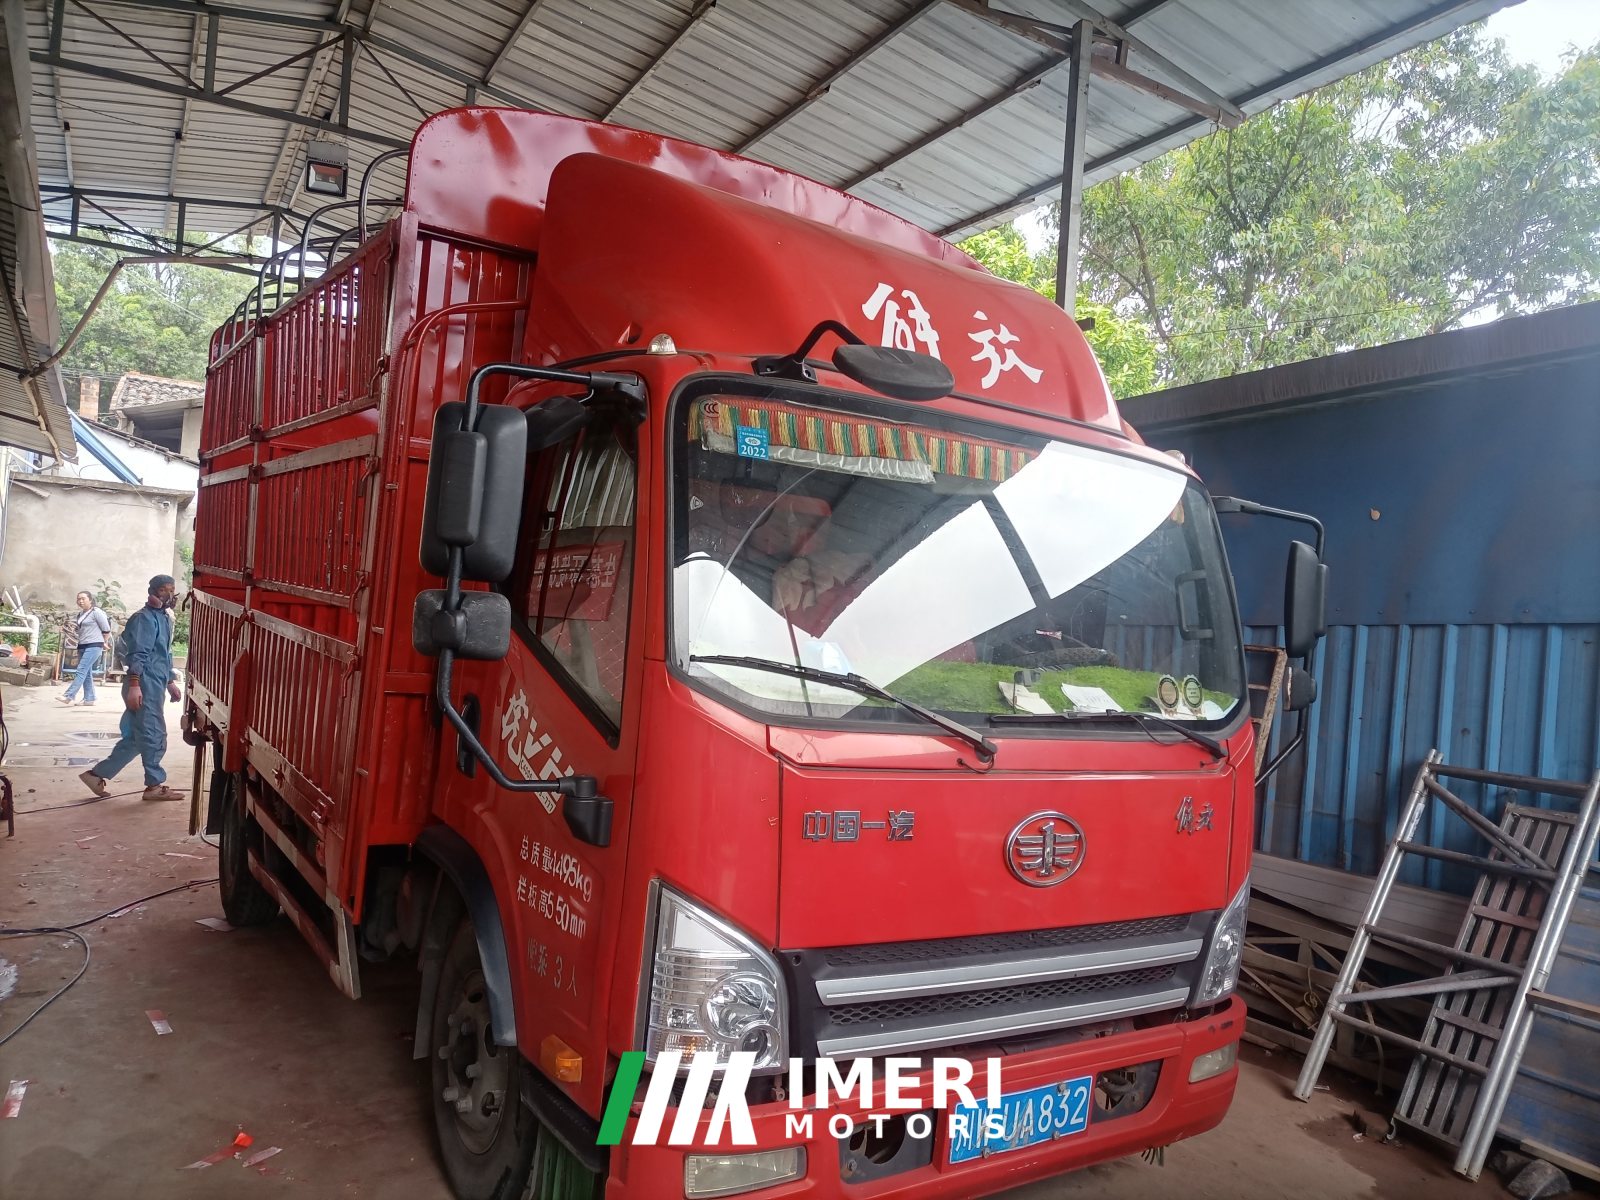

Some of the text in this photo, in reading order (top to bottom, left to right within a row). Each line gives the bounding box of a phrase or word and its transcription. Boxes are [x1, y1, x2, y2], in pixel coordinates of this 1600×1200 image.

[741, 444, 767, 458] 2022
[803, 810, 915, 842] 中国一汽
